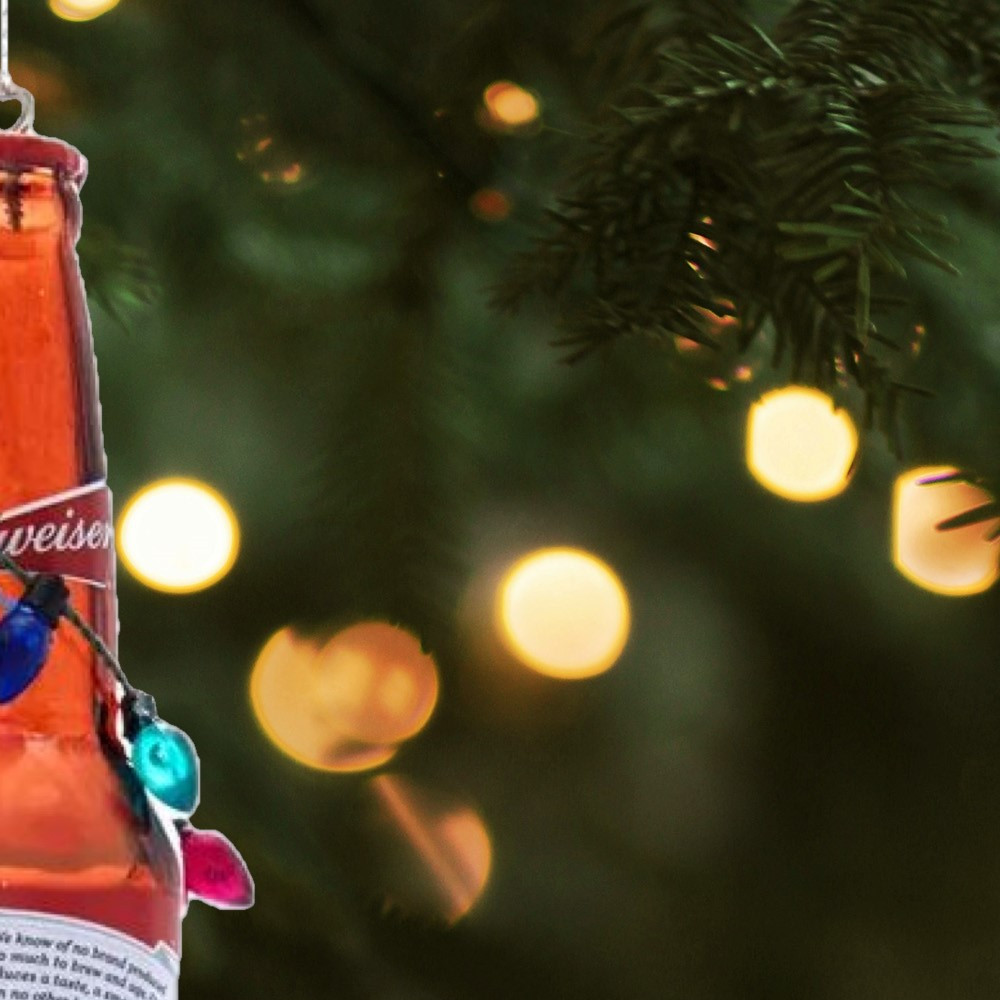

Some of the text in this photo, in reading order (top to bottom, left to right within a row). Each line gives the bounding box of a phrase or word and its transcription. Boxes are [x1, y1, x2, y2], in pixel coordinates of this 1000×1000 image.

[15, 932, 54, 949] know
[56, 939, 73, 951] of
[73, 944, 90, 956] no
[10, 953, 50, 967] much
[54, 956, 68, 969] to
[10, 989, 29, 1000] no
